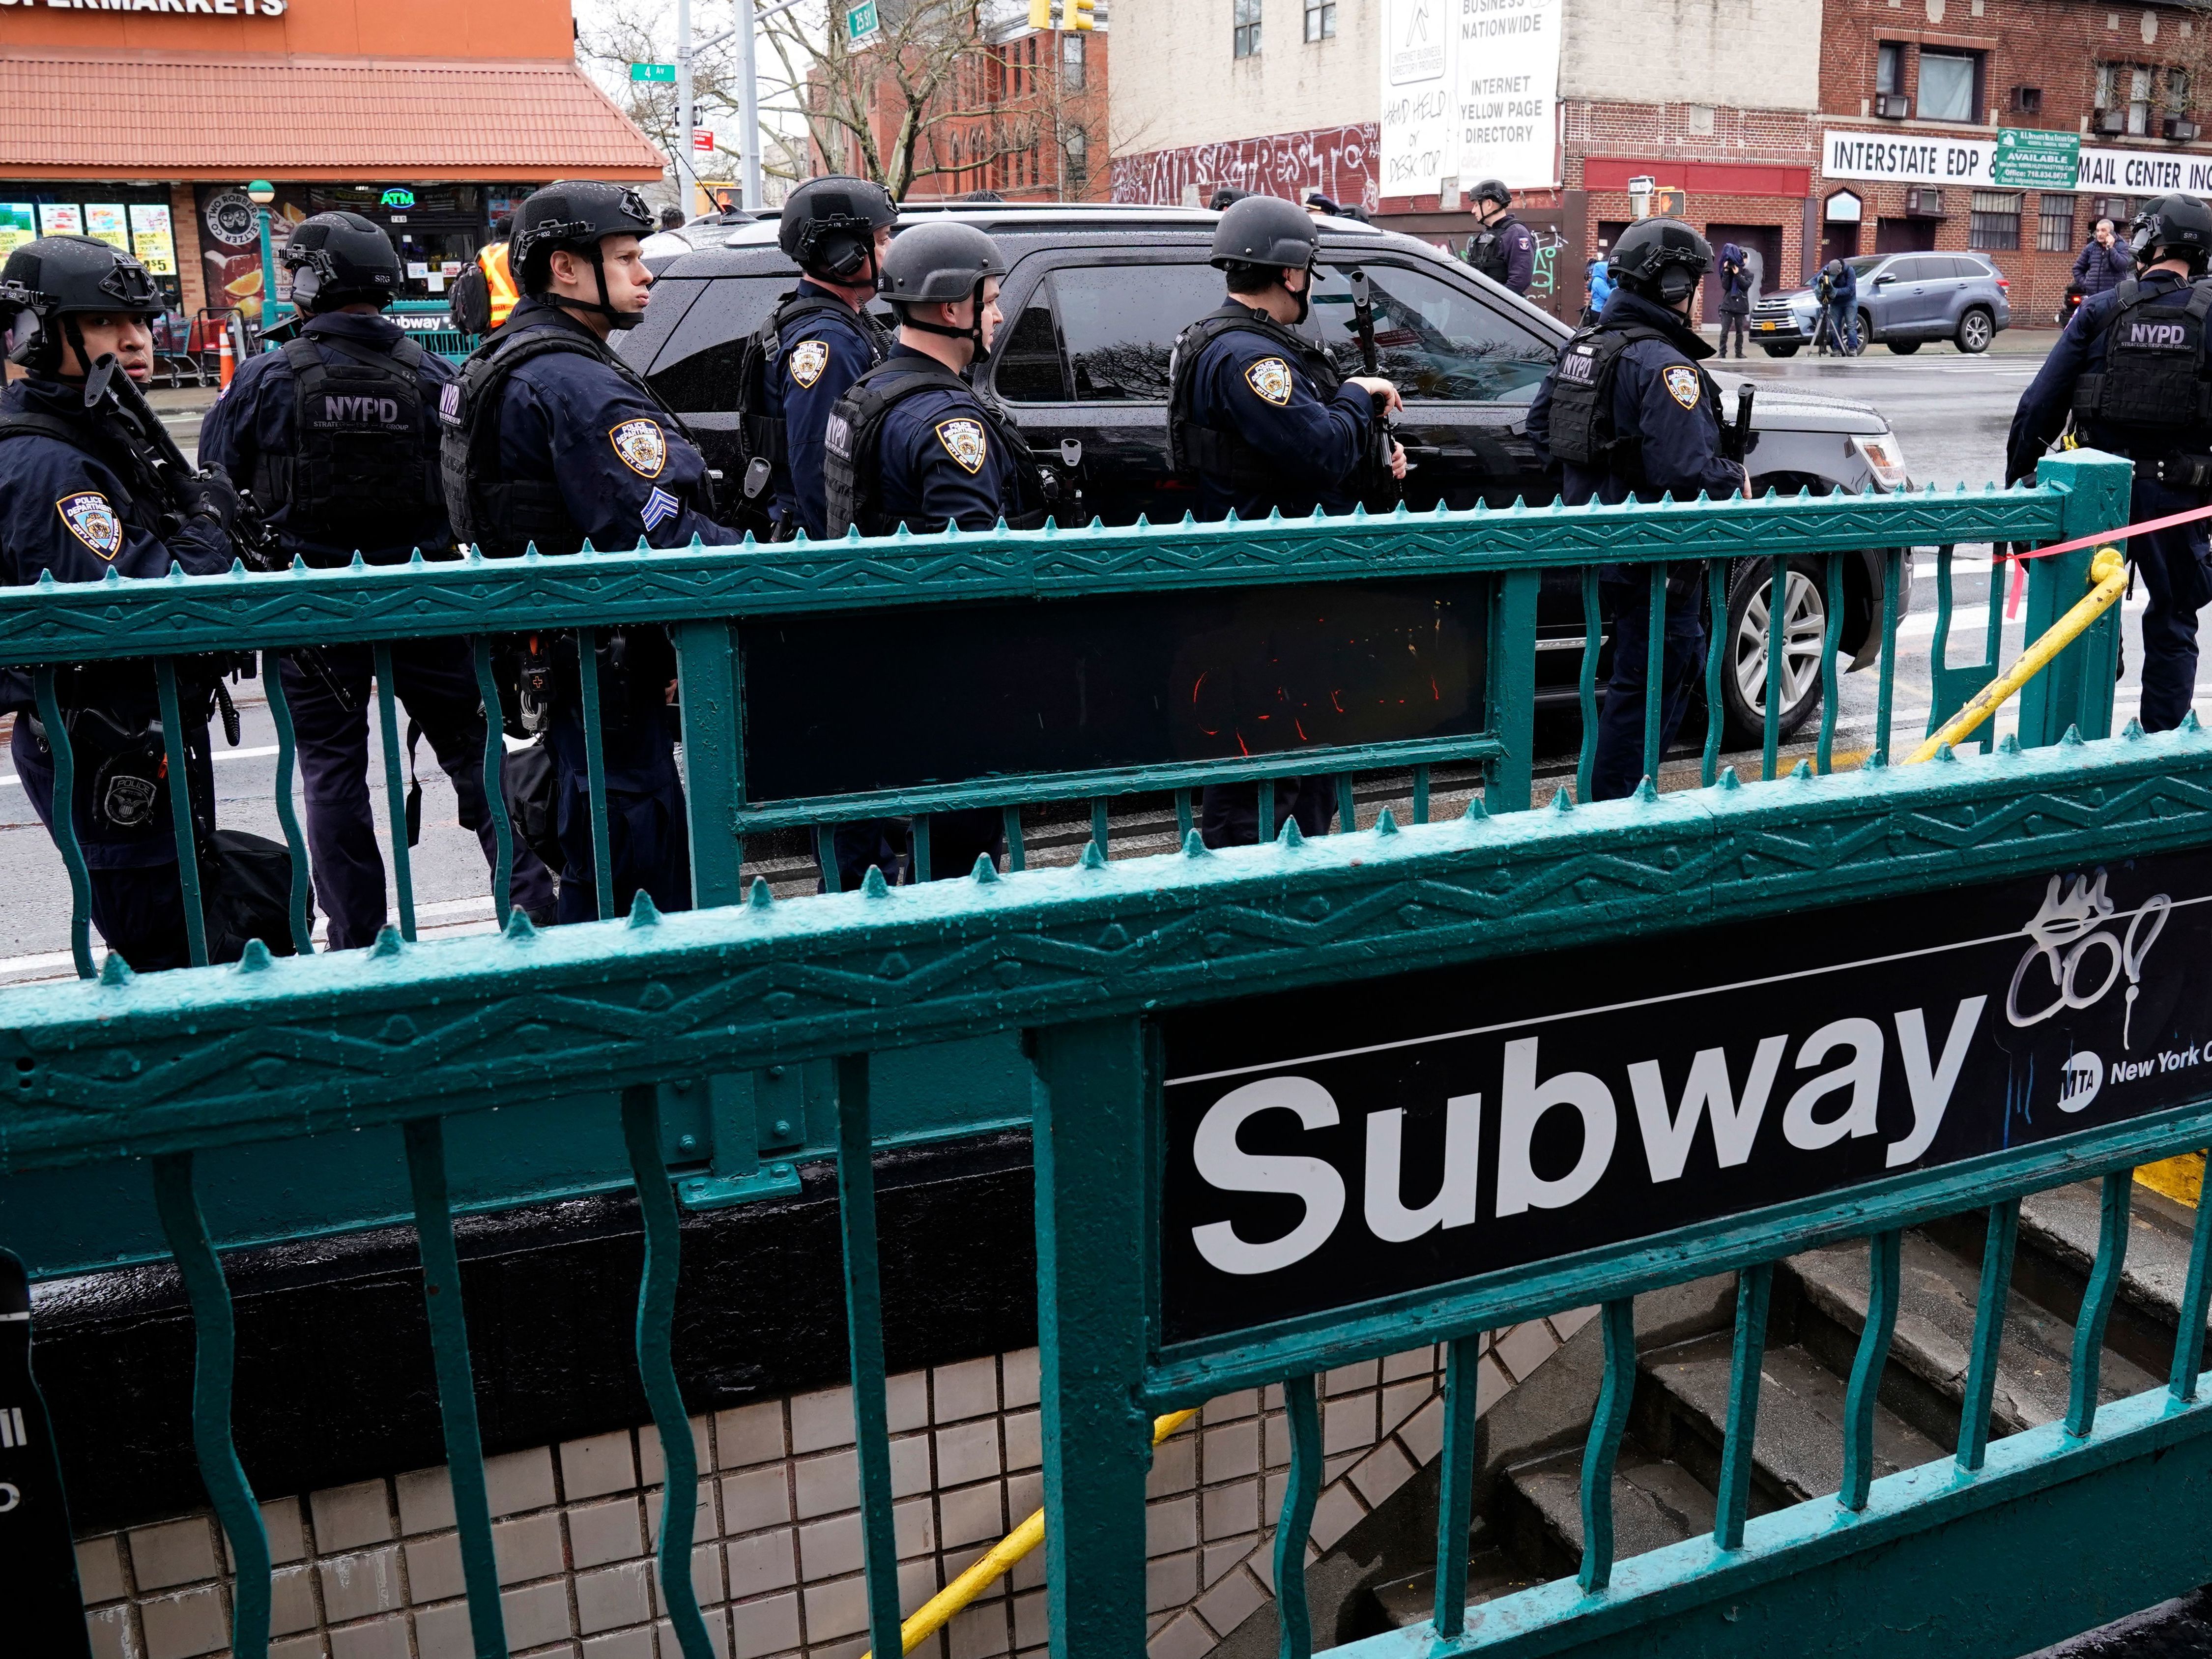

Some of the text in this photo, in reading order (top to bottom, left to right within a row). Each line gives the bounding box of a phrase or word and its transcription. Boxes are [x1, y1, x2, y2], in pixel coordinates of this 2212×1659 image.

[1462, 14, 1542, 40] NATIONWIDE
[645, 66, 651, 78] 4
[1471, 75, 1531, 95] INTERNET
[1413, 90, 1446, 123] HELD
[1461, 100, 1543, 119] YELLOW PAGE
[1465, 125, 1534, 143] DIRECTORY
[1834, 141, 1937, 174] INTERSTATE
[1947, 148, 1979, 176] EDP
[2076, 156, 2116, 184] MAIL
[2126, 159, 2181, 189] CENTER
[2008, 153, 2068, 163] AVAILABLE
[222, 195, 259, 218] ROBBERS
[381, 193, 415, 204] ATM
[209, 201, 221, 220] TWO
[225, 223, 259, 243] SELTZER
[375, 275, 390, 284] SRG
[2131, 323, 2185, 344] NYPD
[1255, 360, 1275, 372] POLICE
[1563, 353, 1592, 378] NYPD
[439, 382, 460, 416] NYPD
[326, 396, 398, 423] NYPD
[616, 428, 657, 445] DEPARTMENT
[622, 422, 647, 433] POLICE
[826, 413, 847, 449] NYPD
[622, 451, 635, 464] CITY
[653, 457, 661, 470] NEW
[66, 503, 113, 517] DEPARTMEN
[74, 496, 103, 506] POLICE
[73, 524, 100, 549] CITY OF
[109, 536, 118, 551] NEW
[117, 780, 150, 794] POLICE
[2111, 1059, 2155, 1084] New
[2158, 1046, 2201, 1073] York
[1191, 994, 1988, 1275] Subway
